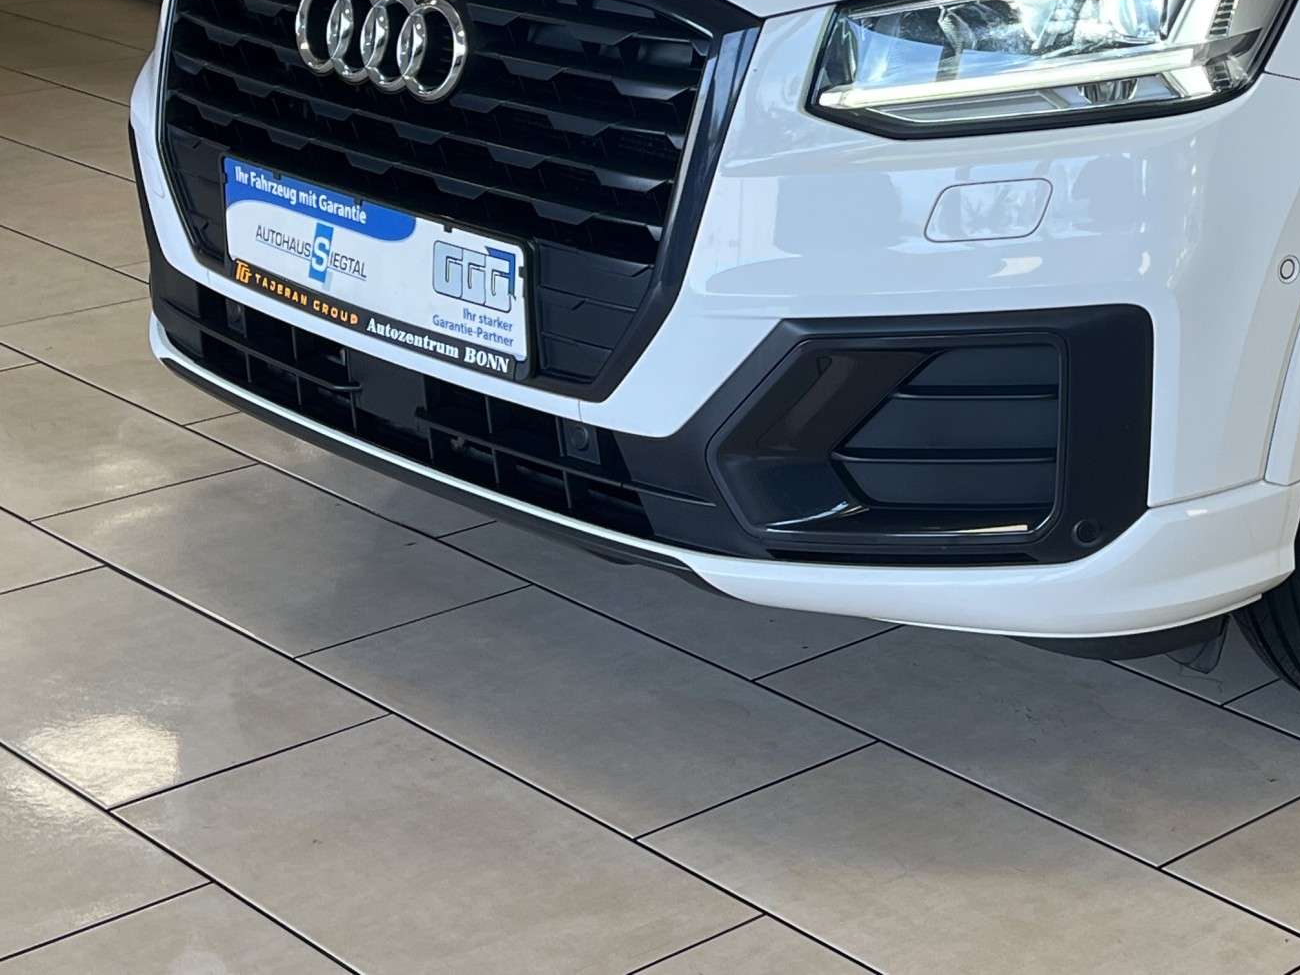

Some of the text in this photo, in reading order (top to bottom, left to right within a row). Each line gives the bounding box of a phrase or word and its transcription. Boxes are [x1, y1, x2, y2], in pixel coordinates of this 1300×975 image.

[234, 166, 367, 224] Ihr Fahrzeug mit Garantie
[255, 225, 312, 258] AUTOHAUS
[255, 274, 308, 306] TAJERAN
[313, 299, 359, 325] GROUP
[463, 307, 513, 331] Ihr starker
[366, 317, 510, 374] Autozentrum BONN
[432, 314, 514, 347] Garantie-Partner
